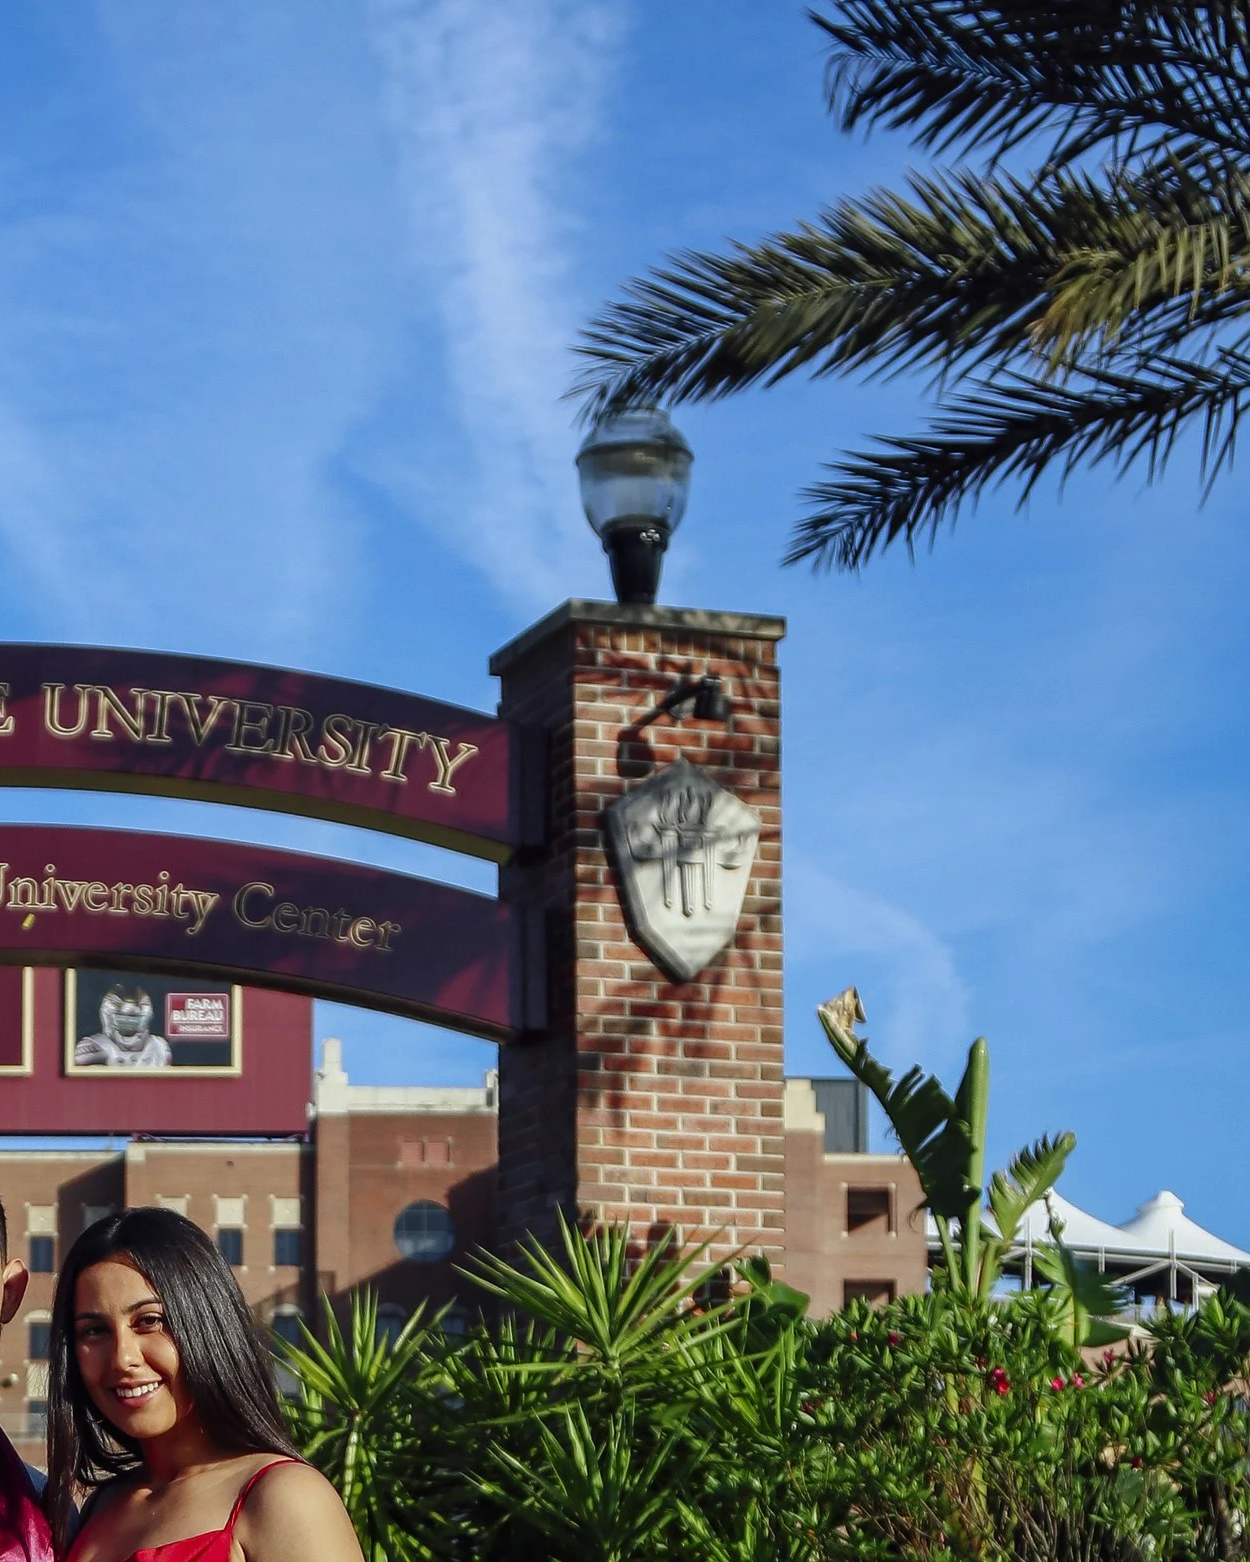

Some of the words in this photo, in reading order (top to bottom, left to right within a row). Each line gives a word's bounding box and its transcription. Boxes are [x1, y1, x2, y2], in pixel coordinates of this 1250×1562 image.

[42, 681, 479, 794] UNIVERSITY
[233, 881, 402, 951] Center
[186, 998, 223, 1009] FARM
[172, 1009, 223, 1021] BUREAU
[178, 1024, 225, 1032] INSURANCE
